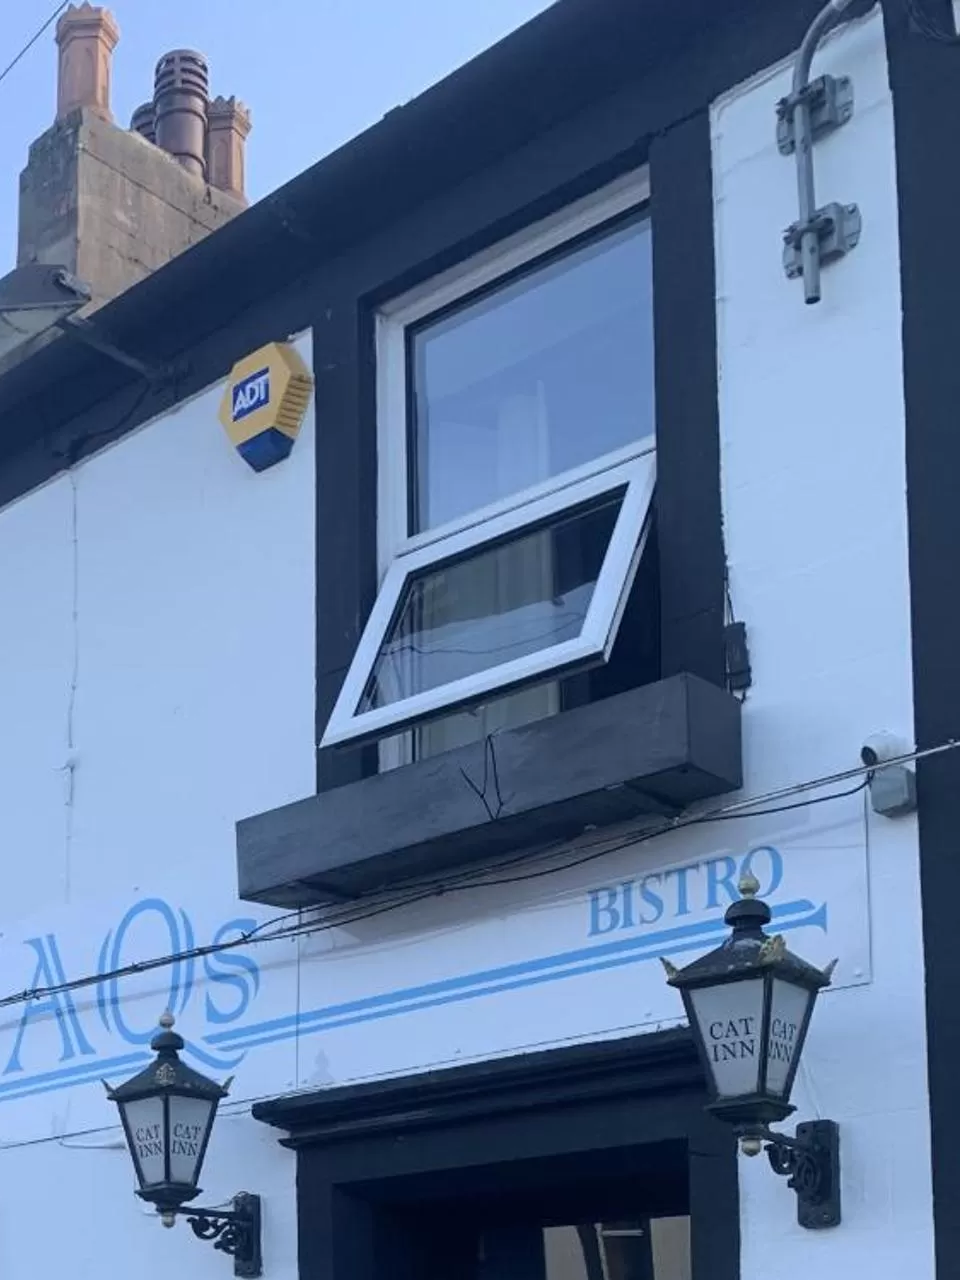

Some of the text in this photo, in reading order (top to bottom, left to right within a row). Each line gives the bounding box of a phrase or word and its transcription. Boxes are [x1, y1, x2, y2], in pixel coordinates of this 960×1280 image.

[233, 376, 270, 415] ADT
[586, 845, 784, 937] BISTRO
[709, 1017, 754, 1040] CAT
[771, 1018, 796, 1041] CAT
[712, 1040, 756, 1063] INN
[768, 1040, 792, 1063] INN
[135, 1124, 161, 1142] CAT
[173, 1123, 201, 1142] CAT
[137, 1140, 164, 1159] INN
[171, 1140, 199, 1157] INN
